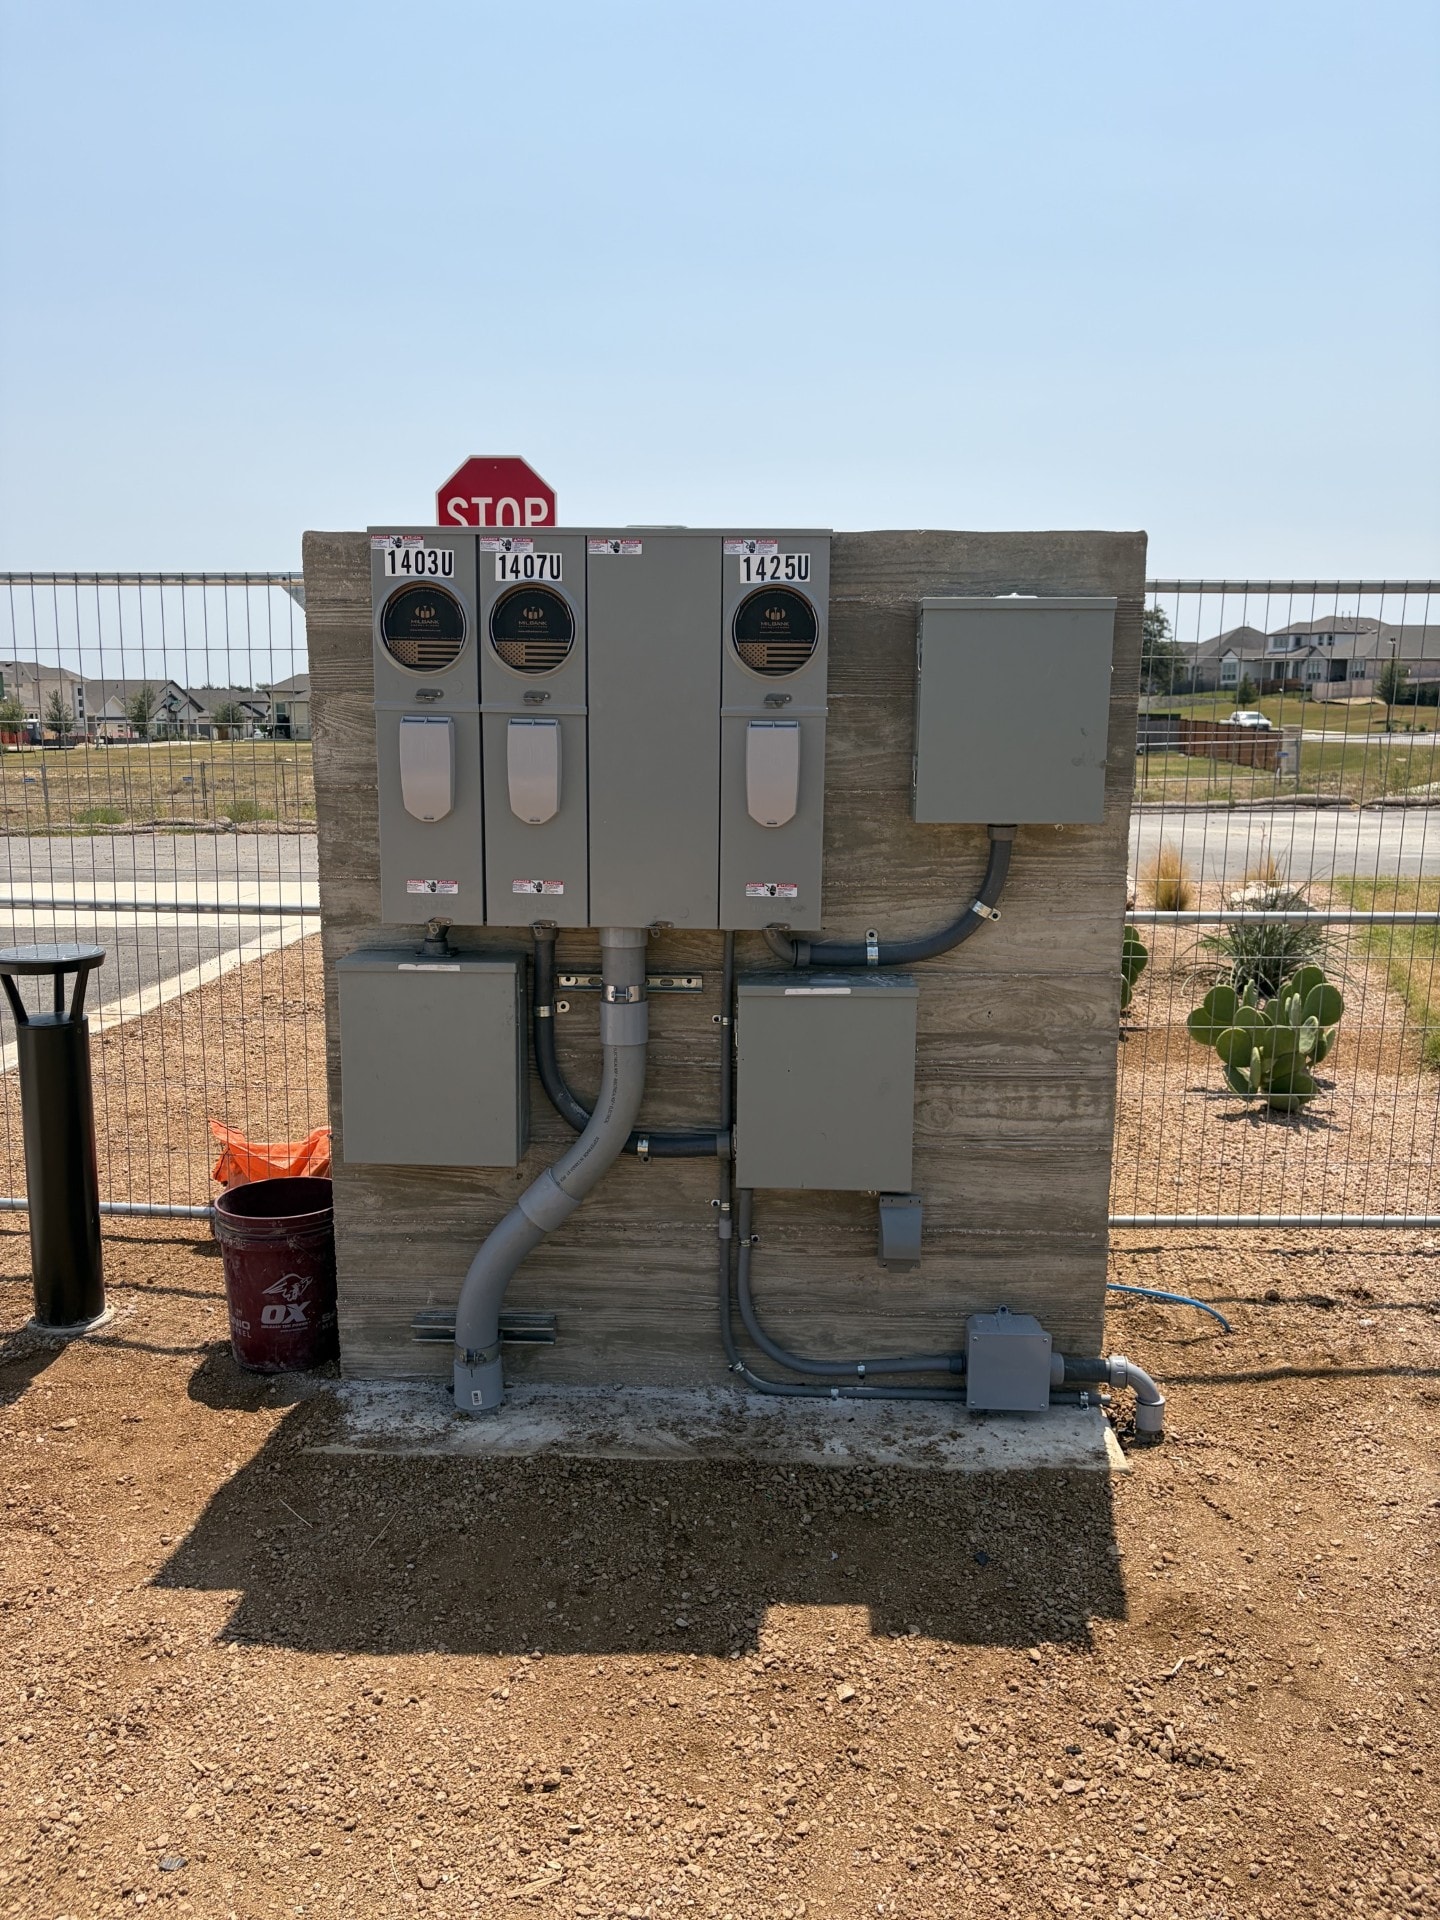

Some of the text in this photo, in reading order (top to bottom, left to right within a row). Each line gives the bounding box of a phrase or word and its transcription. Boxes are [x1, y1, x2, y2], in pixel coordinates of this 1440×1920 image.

[446, 497, 548, 526] STOP
[387, 549, 453, 577] 1403U
[498, 554, 561, 580] 1407U
[743, 555, 809, 582] 1425U
[261, 1300, 312, 1325] OX
